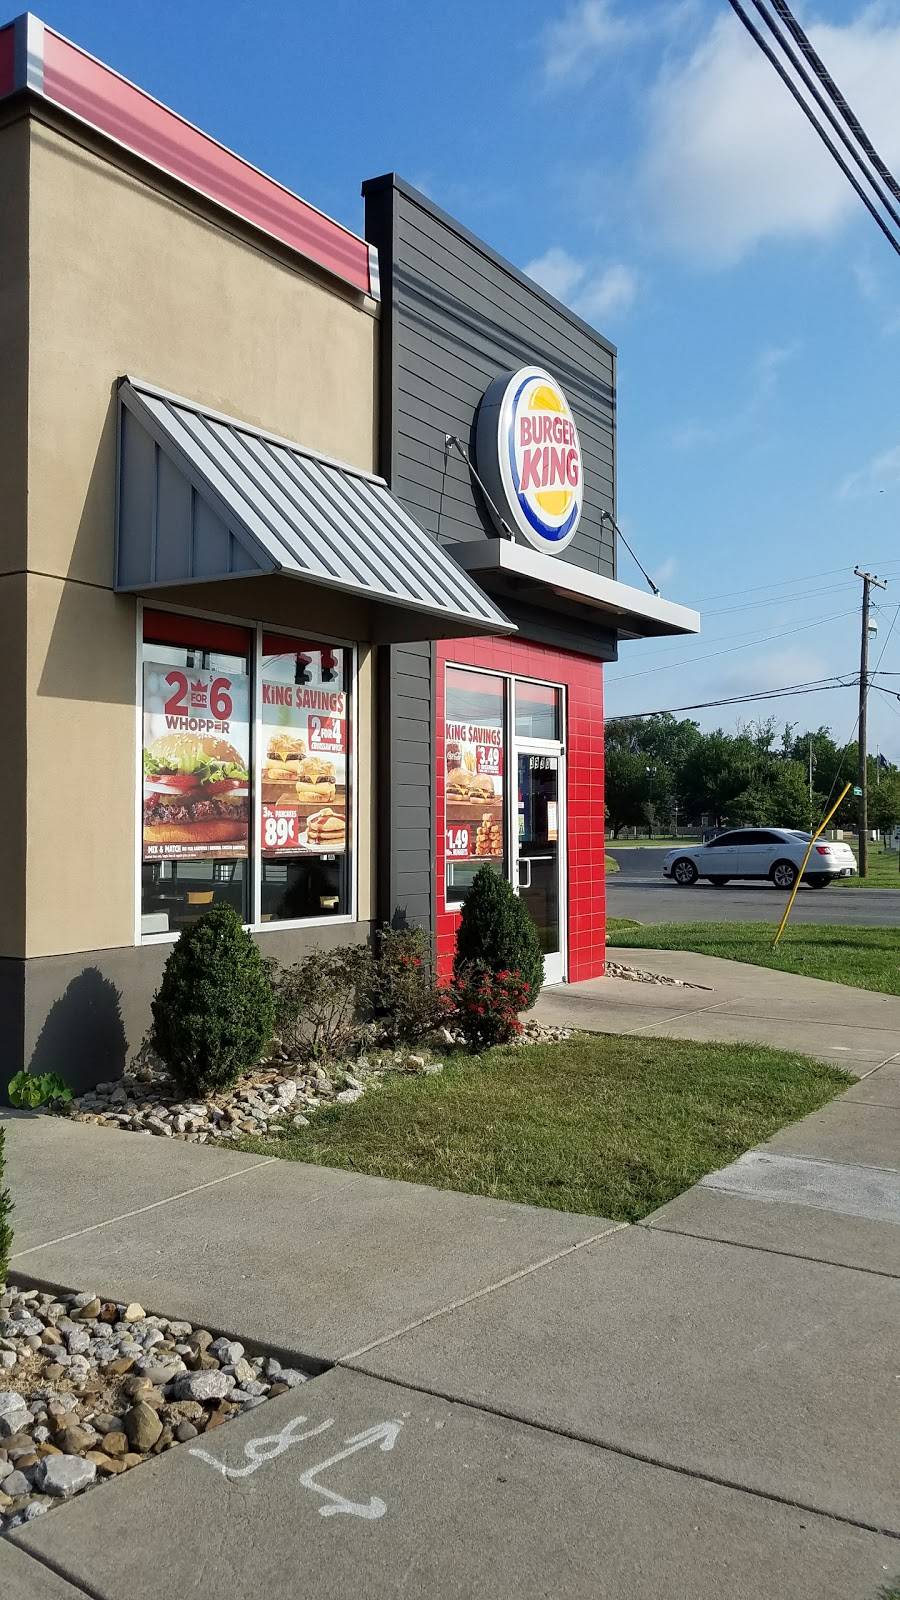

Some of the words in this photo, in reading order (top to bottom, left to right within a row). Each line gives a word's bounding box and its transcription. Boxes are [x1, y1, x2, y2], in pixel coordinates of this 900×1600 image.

[520, 416, 576, 447] BURGER
[519, 446, 578, 491] KING
[164, 671, 189, 717] 2
[191, 693, 208, 704] FOR
[209, 675, 233, 720] $6
[165, 715, 230, 734] WHOPPER
[311, 717, 321, 742] 2
[265, 817, 295, 846] 89¢
[147, 845, 158, 854] MIX
[159, 845, 164, 853] &
[164, 844, 182, 853] MATCH
